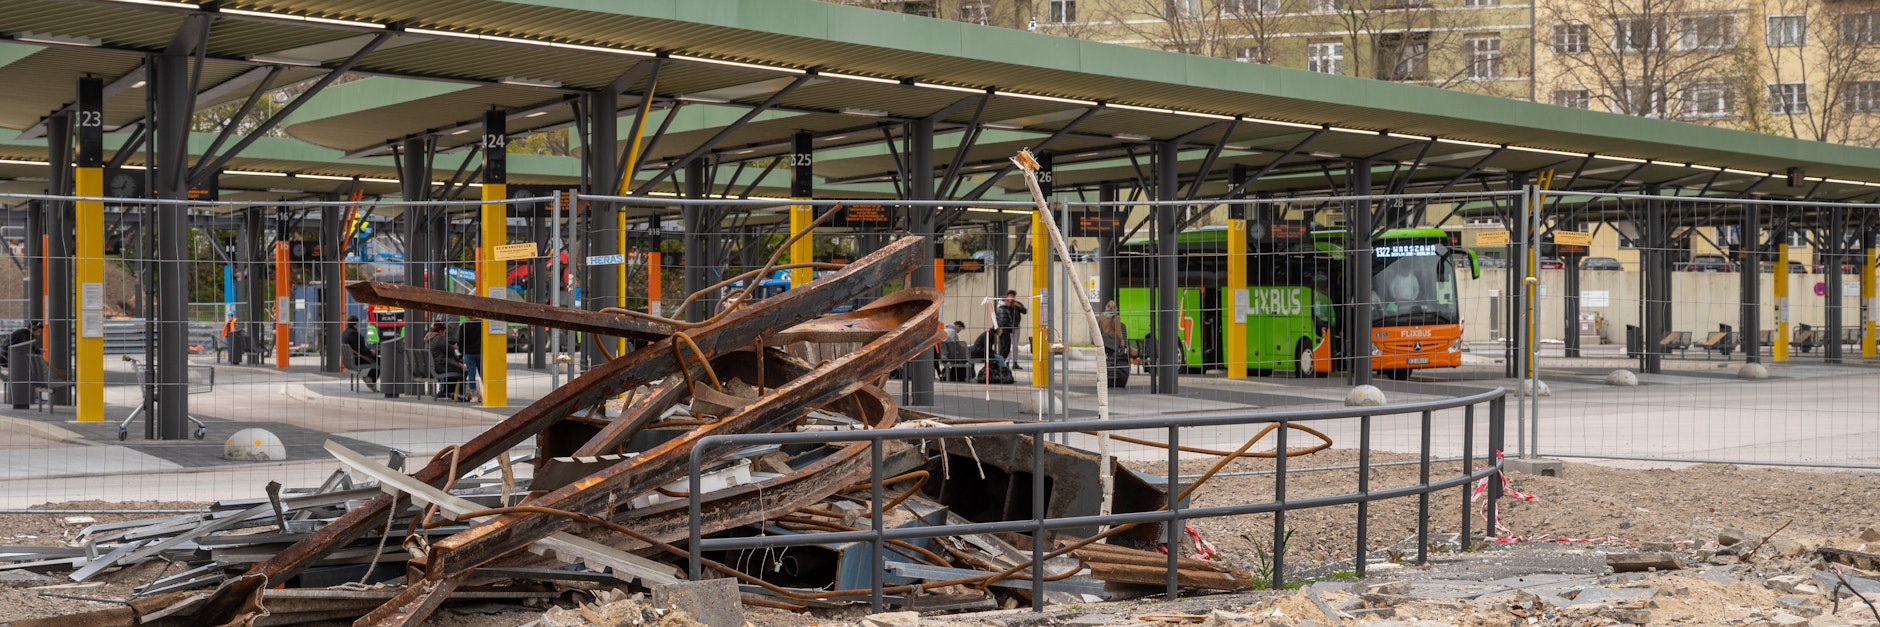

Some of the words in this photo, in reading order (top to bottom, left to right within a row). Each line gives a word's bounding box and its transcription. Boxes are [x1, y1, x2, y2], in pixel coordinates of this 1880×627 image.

[82, 111, 101, 127] 23
[488, 134, 505, 148] 24
[797, 154, 812, 166] 25
[1039, 171, 1052, 183] 26
[590, 255, 623, 265] HERAS
